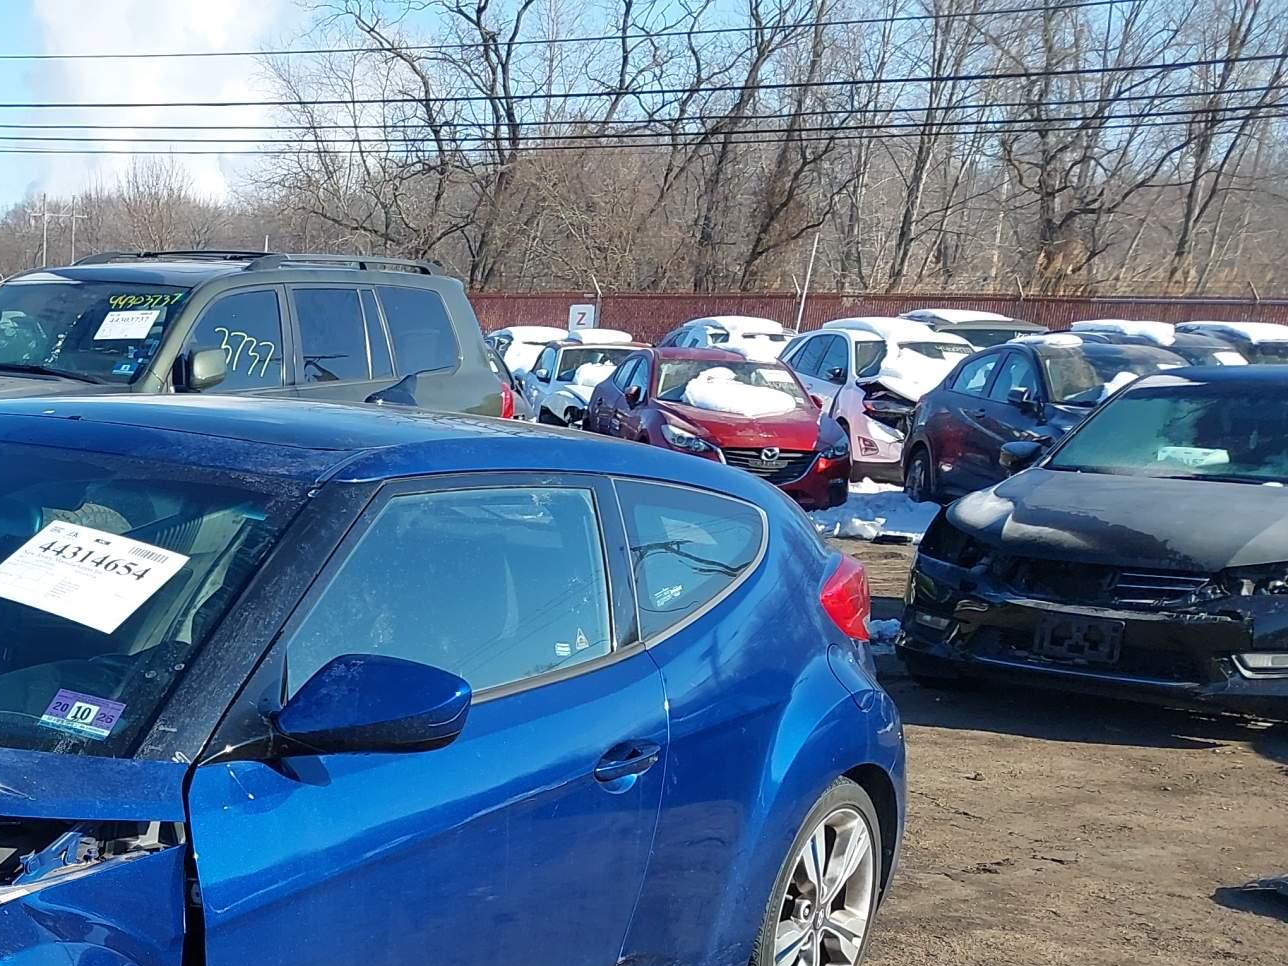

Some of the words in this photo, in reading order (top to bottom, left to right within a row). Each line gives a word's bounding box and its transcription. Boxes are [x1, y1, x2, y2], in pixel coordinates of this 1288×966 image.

[576, 312, 587, 326] Z
[214, 327, 275, 378] 3737
[39, 540, 151, 581] 44314654
[53, 701, 70, 713] 20
[71, 705, 92, 721] 10
[96, 712, 115, 724] 26
